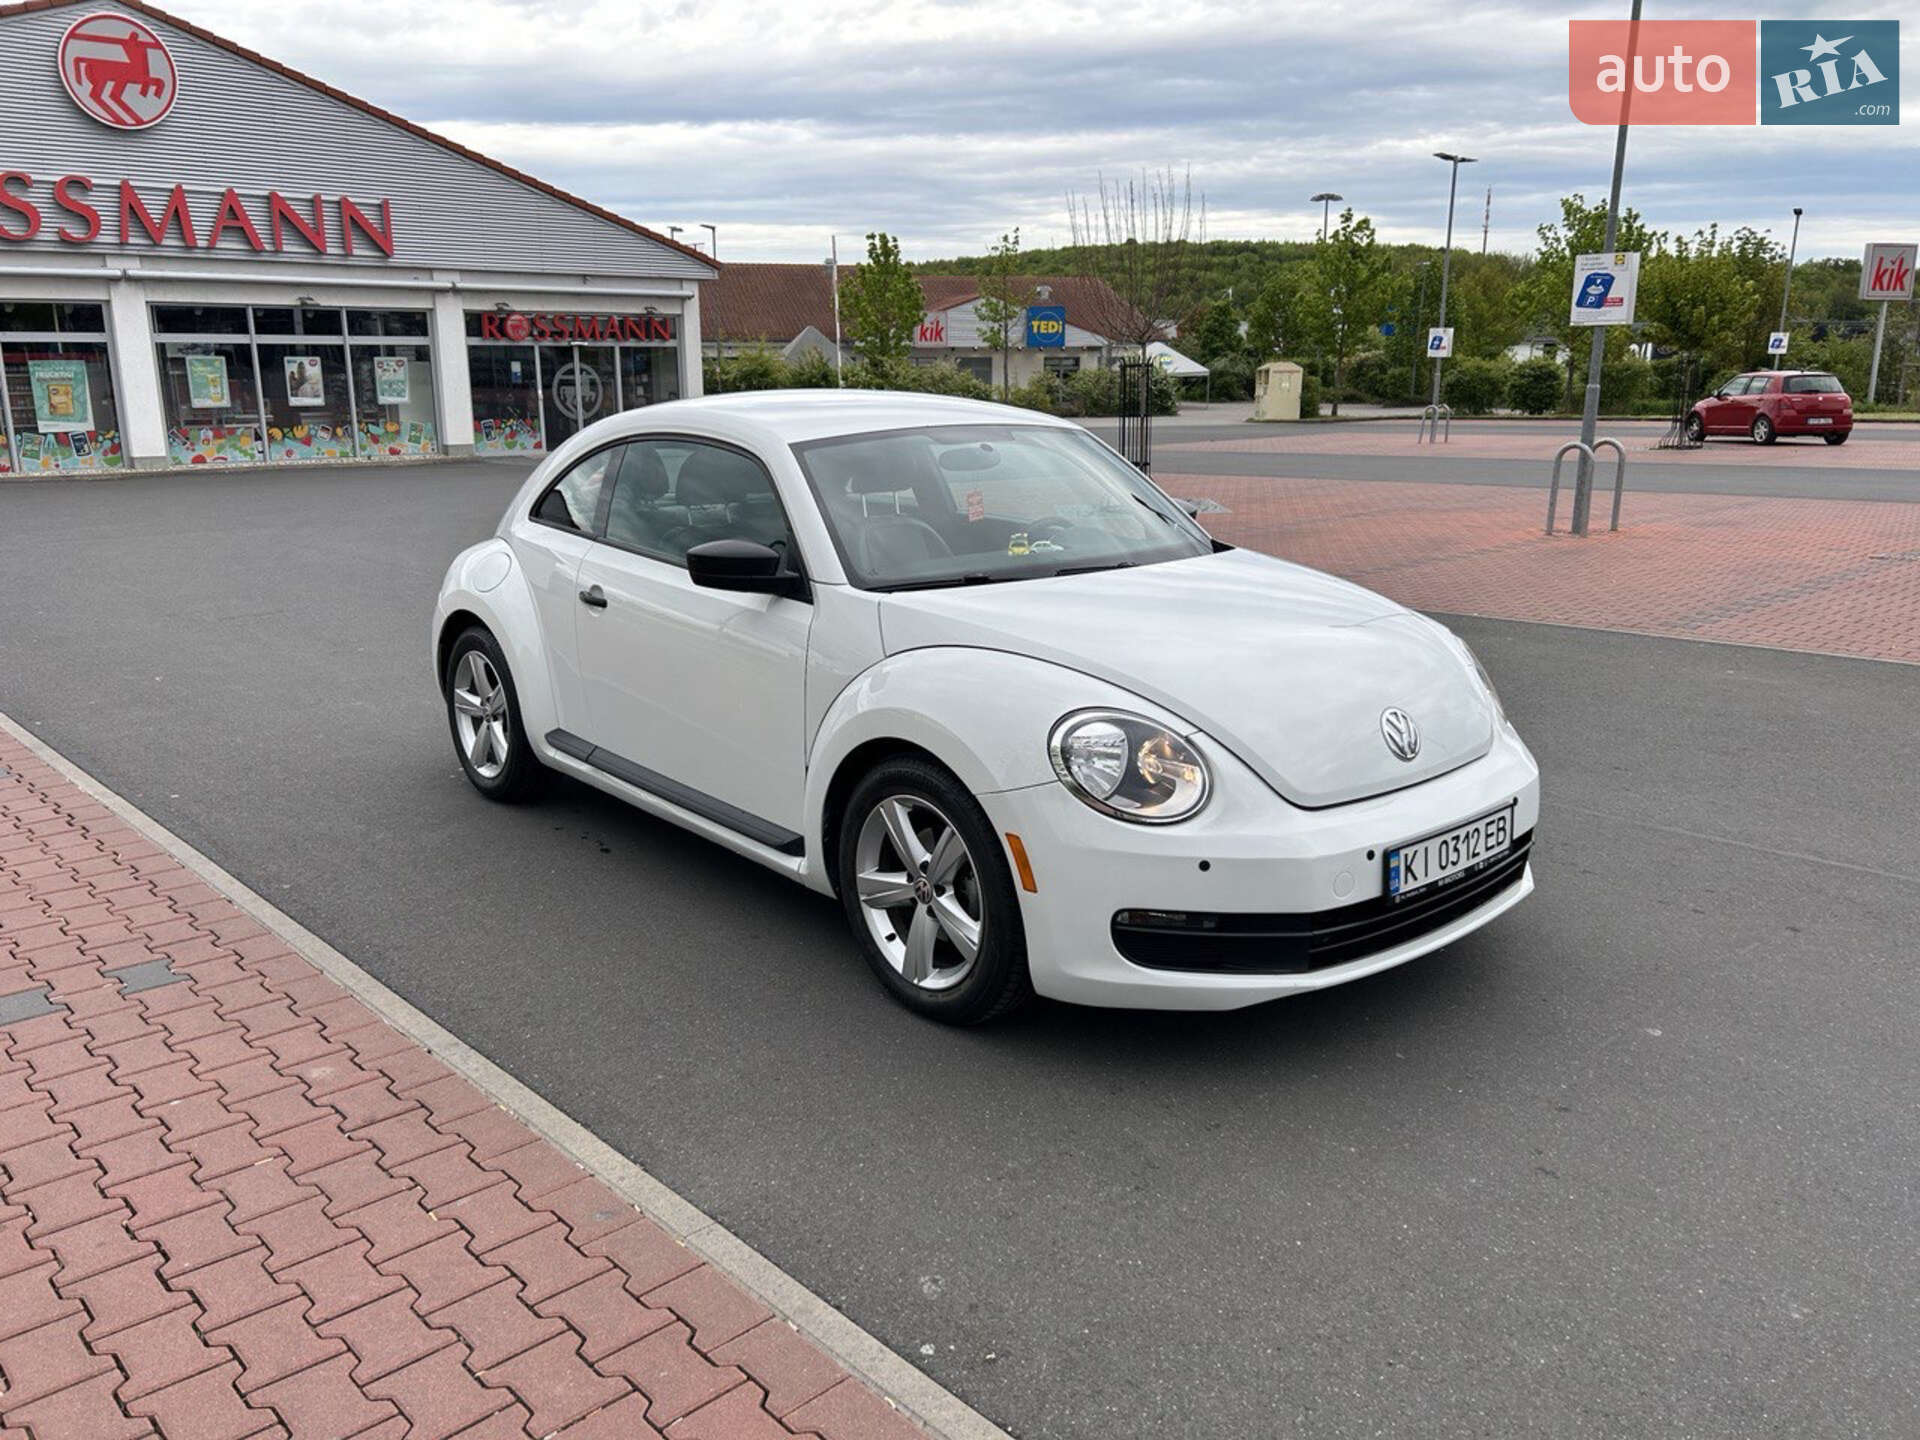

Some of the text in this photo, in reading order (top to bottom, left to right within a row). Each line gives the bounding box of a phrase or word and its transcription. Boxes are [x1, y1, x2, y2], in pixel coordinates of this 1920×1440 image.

[481, 311, 672, 342] ROSSMANN
[1032, 321, 1063, 334] TEDi
[1404, 846, 1428, 885] KI
[1438, 827, 1481, 870] 0312
[1484, 815, 1507, 852] EB
